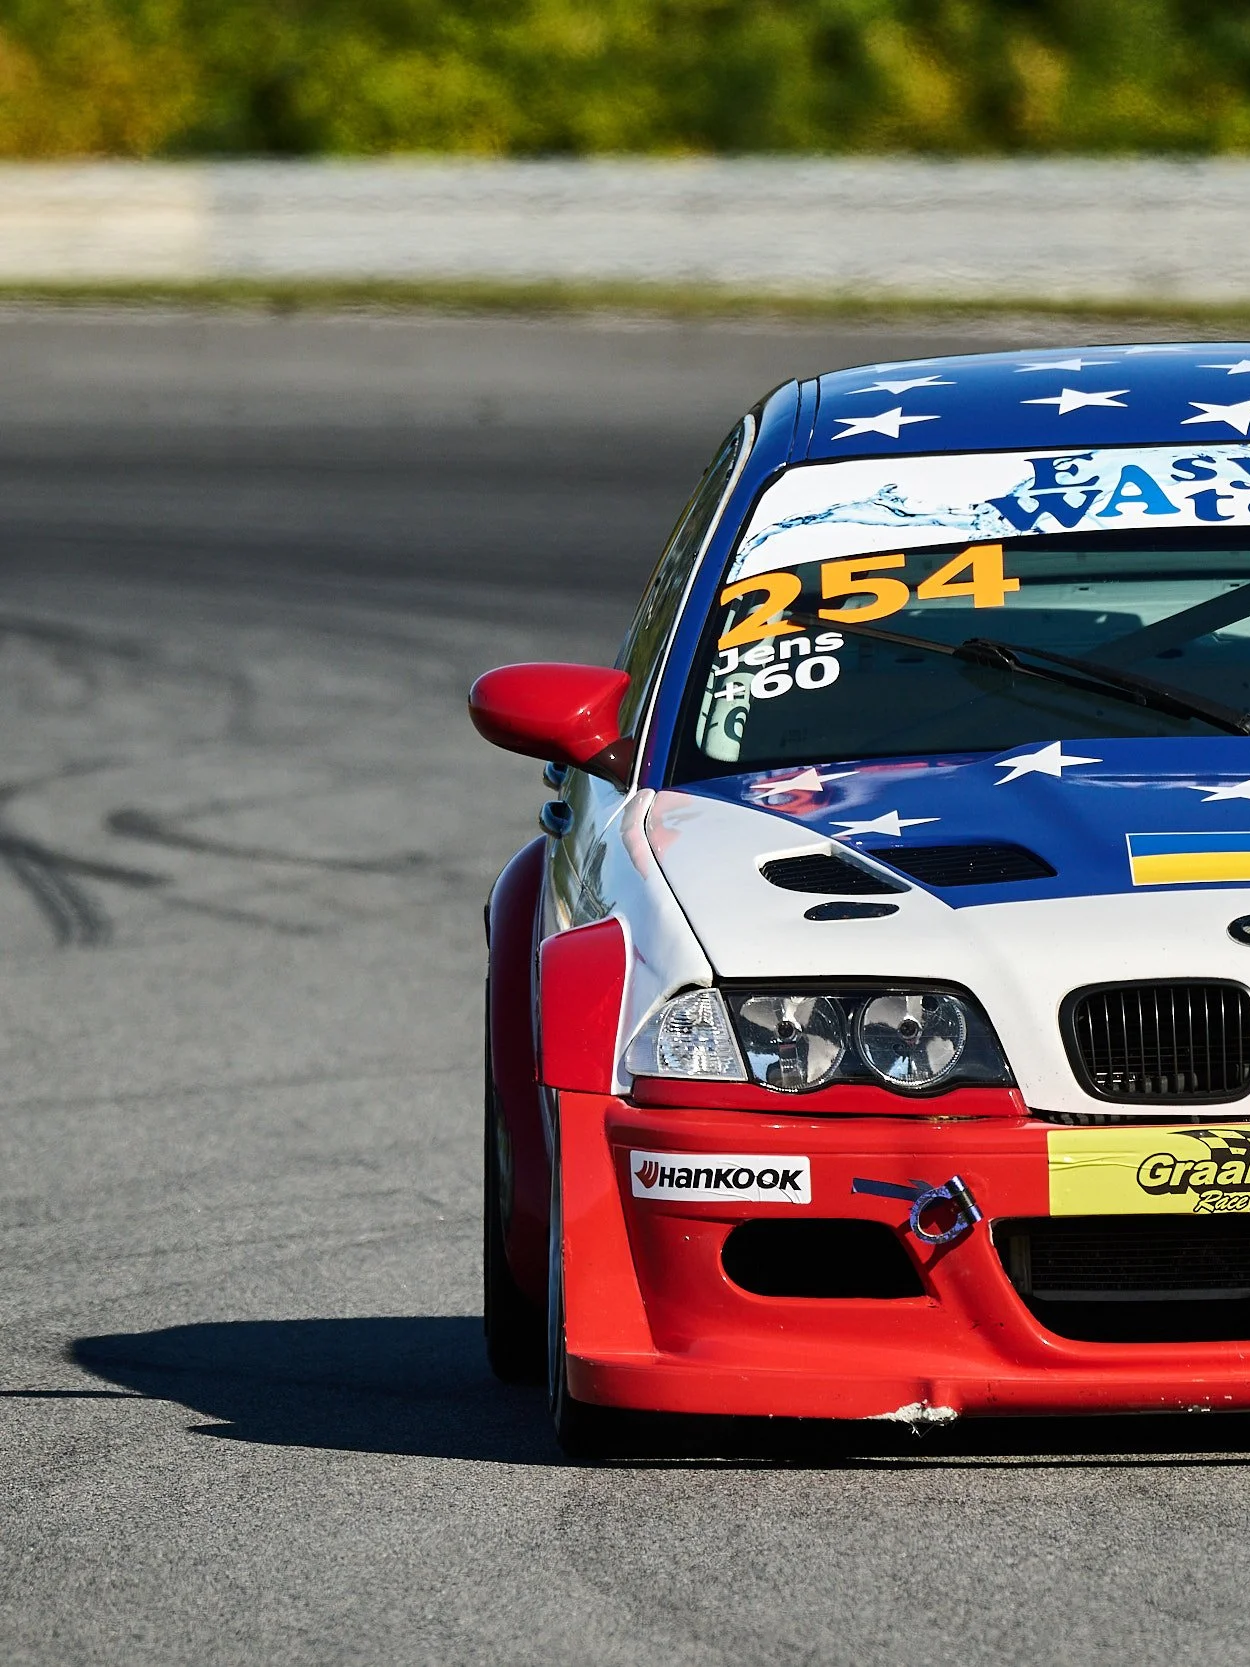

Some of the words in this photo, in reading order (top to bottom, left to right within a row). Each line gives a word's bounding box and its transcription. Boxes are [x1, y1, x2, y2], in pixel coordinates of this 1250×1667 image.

[717, 543, 1021, 651] 254
[714, 631, 845, 677] Jens
[713, 655, 841, 702] +60
[1193, 1189, 1250, 1213] Race
